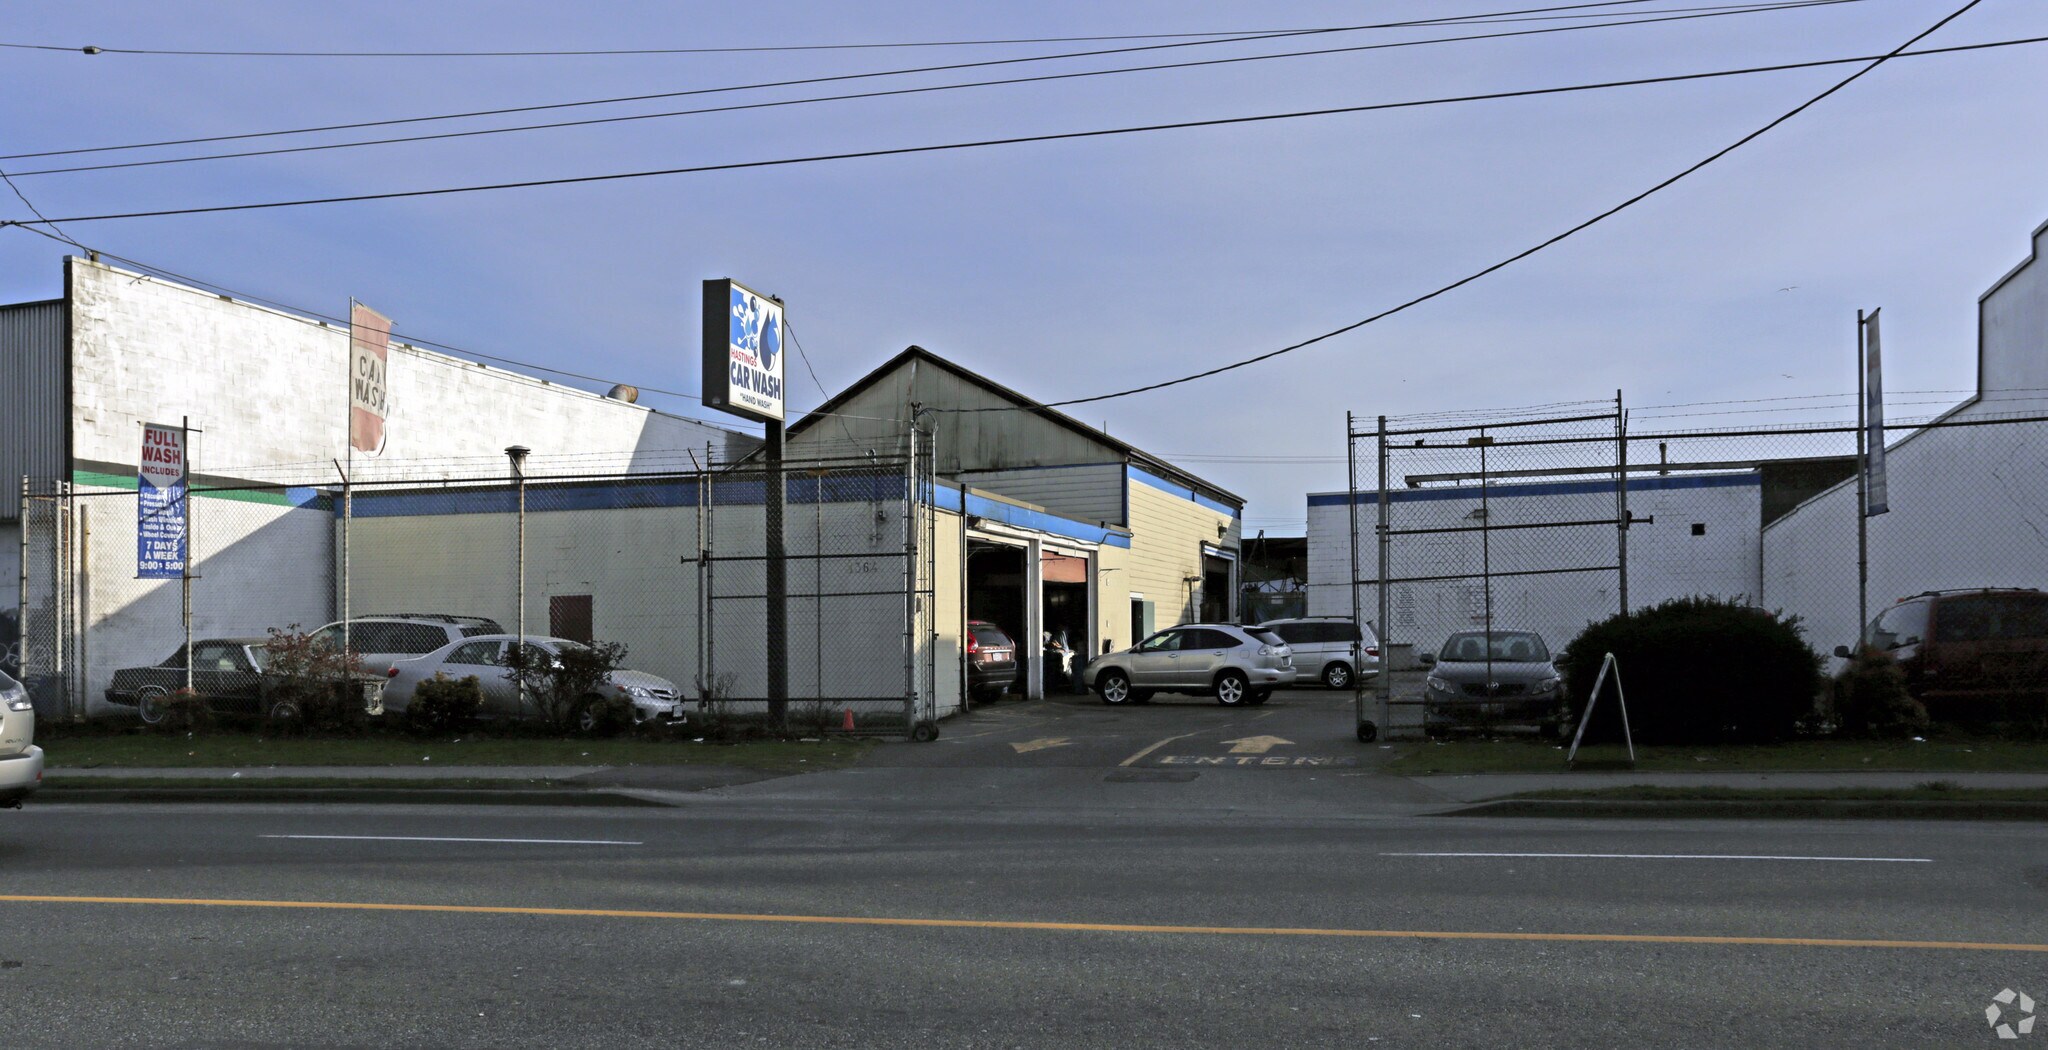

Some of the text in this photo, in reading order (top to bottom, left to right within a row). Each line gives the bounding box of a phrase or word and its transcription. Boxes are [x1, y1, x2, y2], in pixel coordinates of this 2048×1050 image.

[731, 348, 757, 367] HASTINGS
[730, 361, 781, 400] CAR WASH
[355, 378, 386, 411] WASH
[145, 429, 178, 448] FULL
[142, 446, 181, 465] WASH
[142, 465, 180, 477] INCLUDES
[146, 541, 178, 551] 7 DAYS
[144, 551, 179, 560] A WEEK
[139, 560, 158, 570] 9:00
[165, 561, 184, 570] 5:00
[1160, 755, 1325, 766] ENTER
